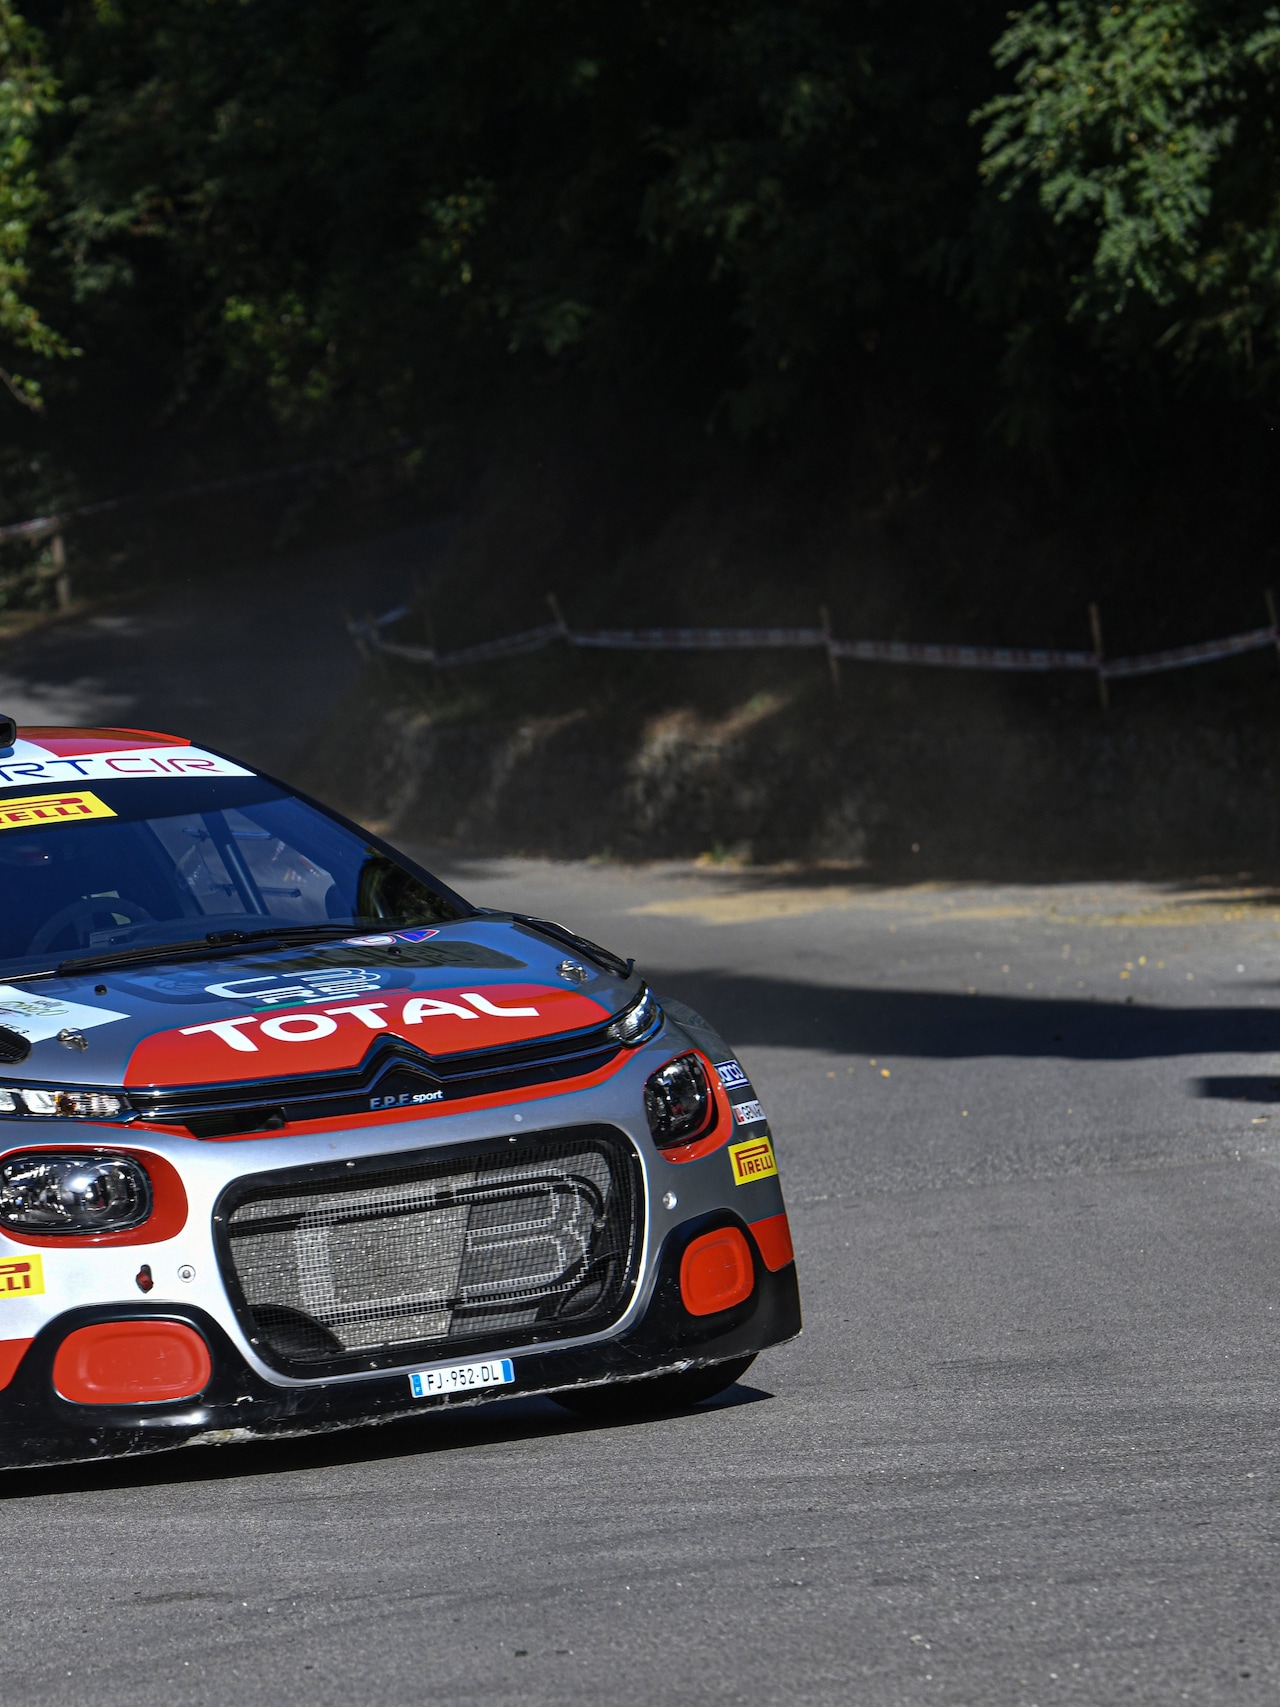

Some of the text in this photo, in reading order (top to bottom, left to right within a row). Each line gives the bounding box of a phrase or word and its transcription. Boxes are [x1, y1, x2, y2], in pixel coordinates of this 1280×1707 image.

[105, 758, 225, 773] CIR
[178, 992, 540, 1052] TOTAL
[412, 1090, 443, 1103] sport
[735, 1144, 773, 1177] PIRELLI
